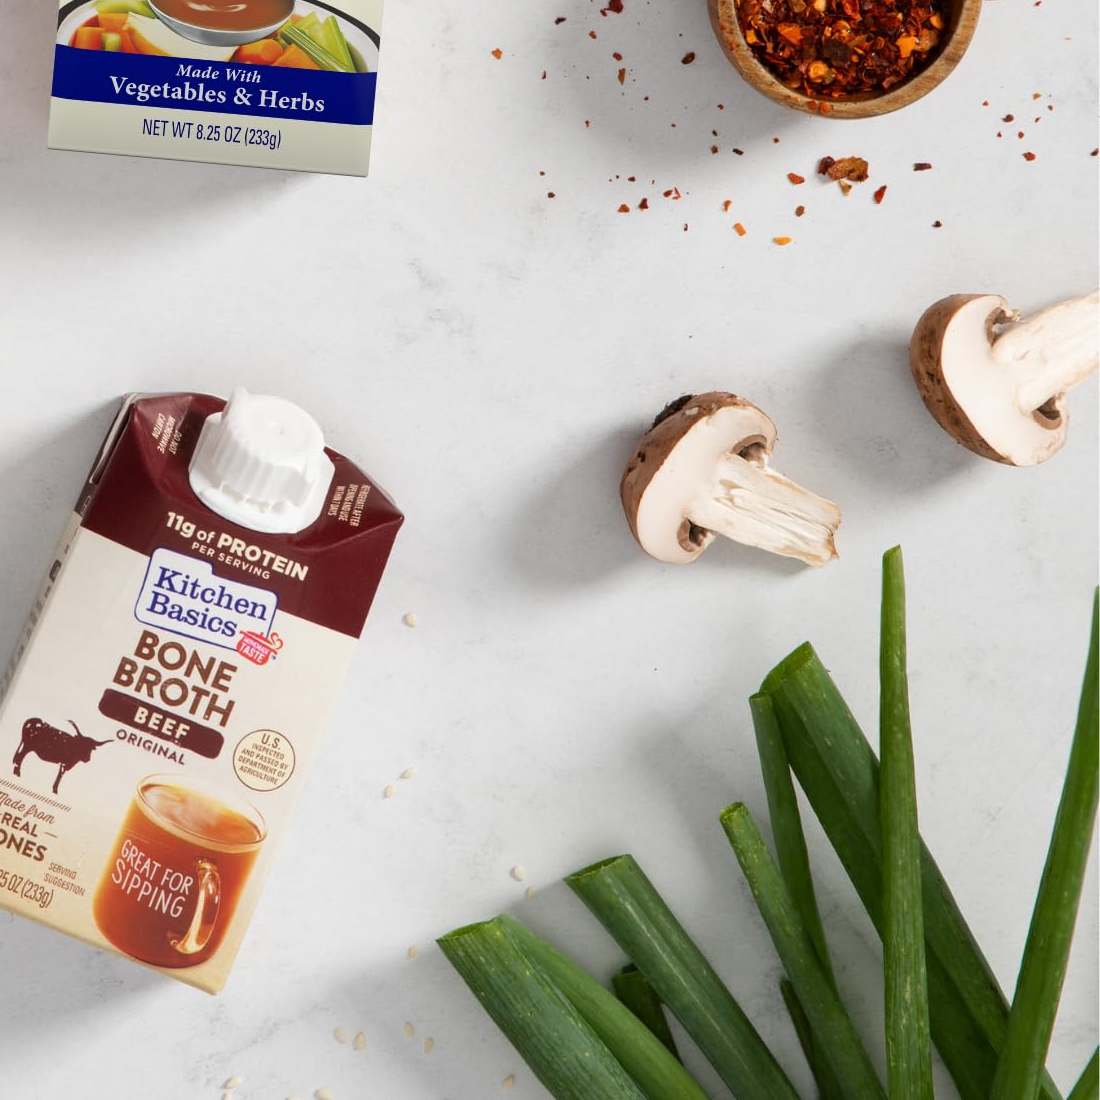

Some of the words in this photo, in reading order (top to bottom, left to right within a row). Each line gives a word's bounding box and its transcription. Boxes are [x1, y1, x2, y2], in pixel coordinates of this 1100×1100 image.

[175, 64, 219, 80] Made
[225, 68, 262, 83] With
[109, 76, 227, 104] Vegetables
[233, 88, 251, 106] &
[258, 89, 325, 112] Herbs
[142, 118, 168, 137] NET
[171, 120, 194, 139] WT
[196, 123, 220, 142] 8.25
[225, 125, 241, 143] OZ
[244, 127, 282, 149] (233g)
[152, 413, 165, 440] CARTON
[167, 511, 196, 538] 11g
[197, 529, 215, 545] of
[218, 534, 309, 581] PROTEIN
[191, 543, 215, 559] PER
[218, 553, 270, 580] SERVING
[154, 566, 268, 620] Kitchen
[146, 591, 237, 637] Basics
[134, 630, 238, 693] BONE
[240, 642, 264, 662] TASTE
[112, 657, 235, 728] BROTH
[134, 706, 190, 740] BEEF
[116, 729, 185, 765] ORIGINAL
[252, 743, 284, 760] INSPECTED
[261, 733, 281, 750] U.S.
[238, 756, 277, 775] DEPARTMENT
[241, 748, 254, 757] AND
[256, 753, 279, 767] PASSED
[239, 765, 278, 784] AGRICULTURE
[0, 814, 38, 837] REAL
[22, 803, 55, 825] from
[48, 862, 77, 879] SERVING
[121, 839, 160, 877] GREAT
[164, 868, 193, 894] FOR
[8, 874, 24, 894] OZ
[21, 880, 56, 908] (233g)
[44, 872, 85, 896] SUGGESTION
[111, 860, 185, 918] SIPPING
